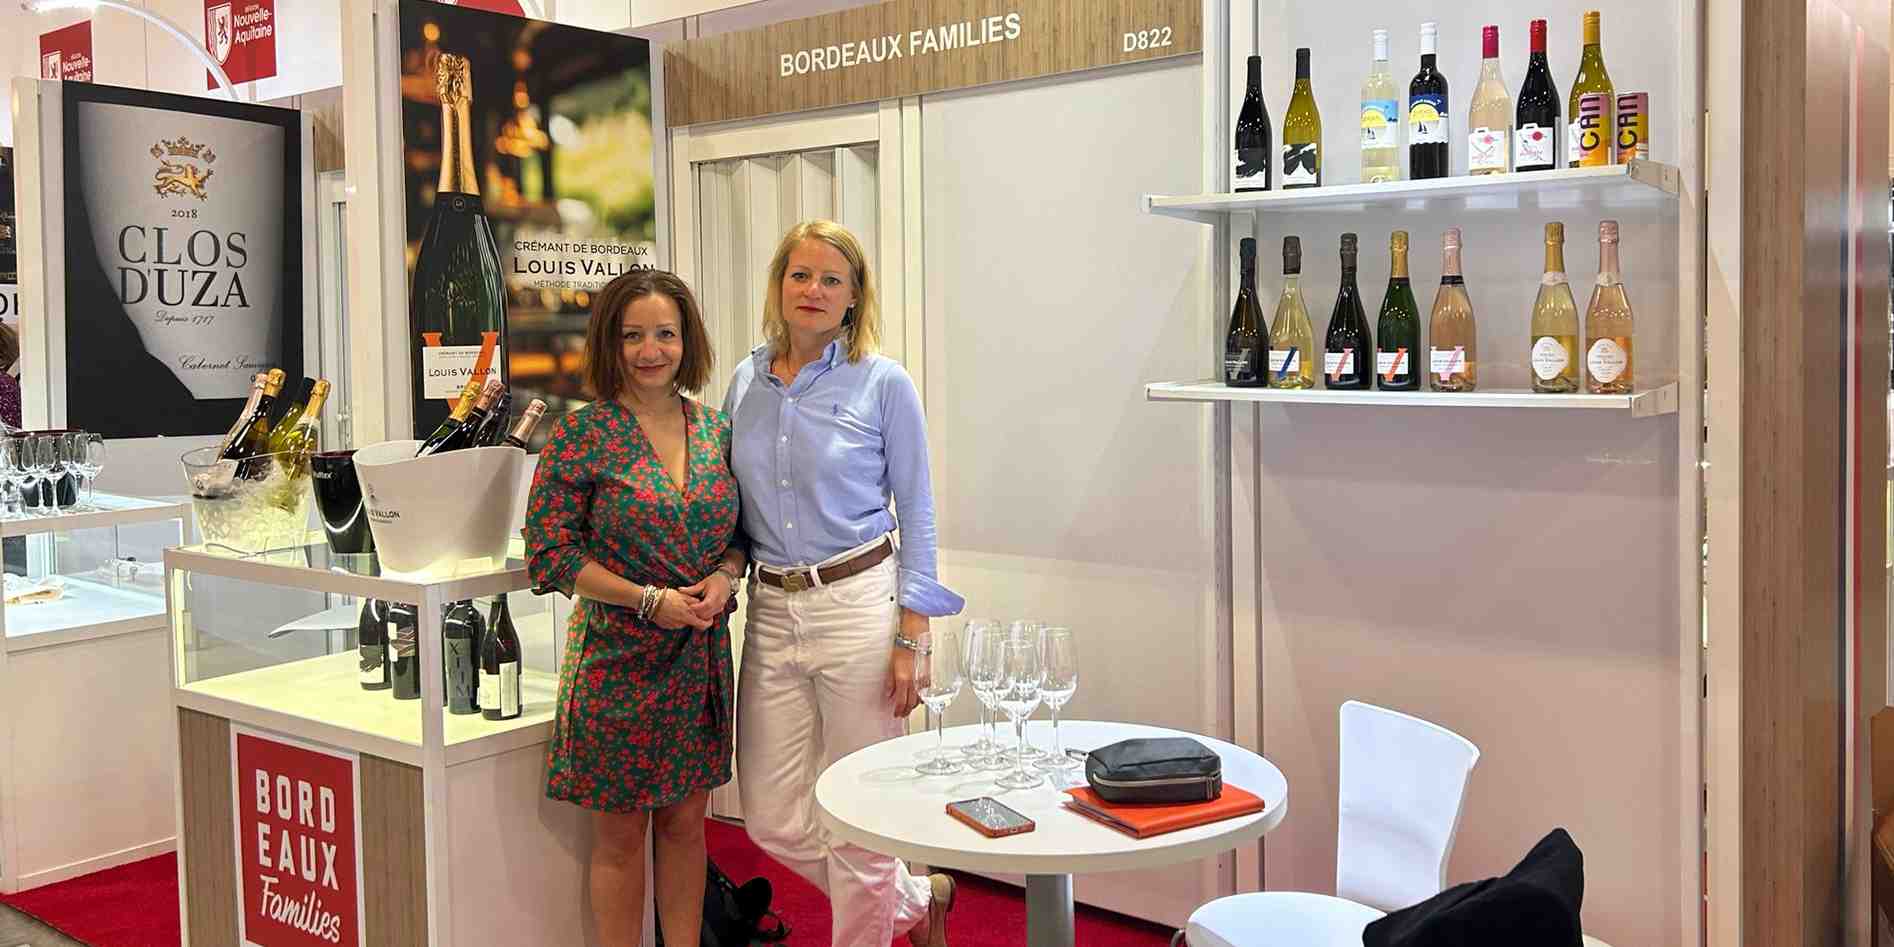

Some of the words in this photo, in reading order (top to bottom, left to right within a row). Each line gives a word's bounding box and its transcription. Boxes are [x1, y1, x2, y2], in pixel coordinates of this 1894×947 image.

[233, 8, 272, 28] Nouvelle-
[234, 25, 272, 47] Aquitaine
[780, 34, 902, 77] BORDEAUX
[909, 13, 1021, 56] FAMILIES
[1123, 26, 1172, 52] D822
[171, 209, 198, 219] 2018
[118, 225, 248, 269] CLOS
[514, 240, 571, 253] CRÉMANT
[573, 244, 588, 253] DE
[590, 244, 648, 256] BORDEAUX
[514, 257, 576, 275] LOUIS
[117, 266, 250, 308] D'UZA
[178, 354, 231, 369] Cabernet
[428, 369, 458, 377] LOUIS
[460, 367, 497, 376] VALLON
[255, 768, 336, 834] BORD
[257, 821, 339, 891] EAUX
[259, 874, 341, 943] Families
